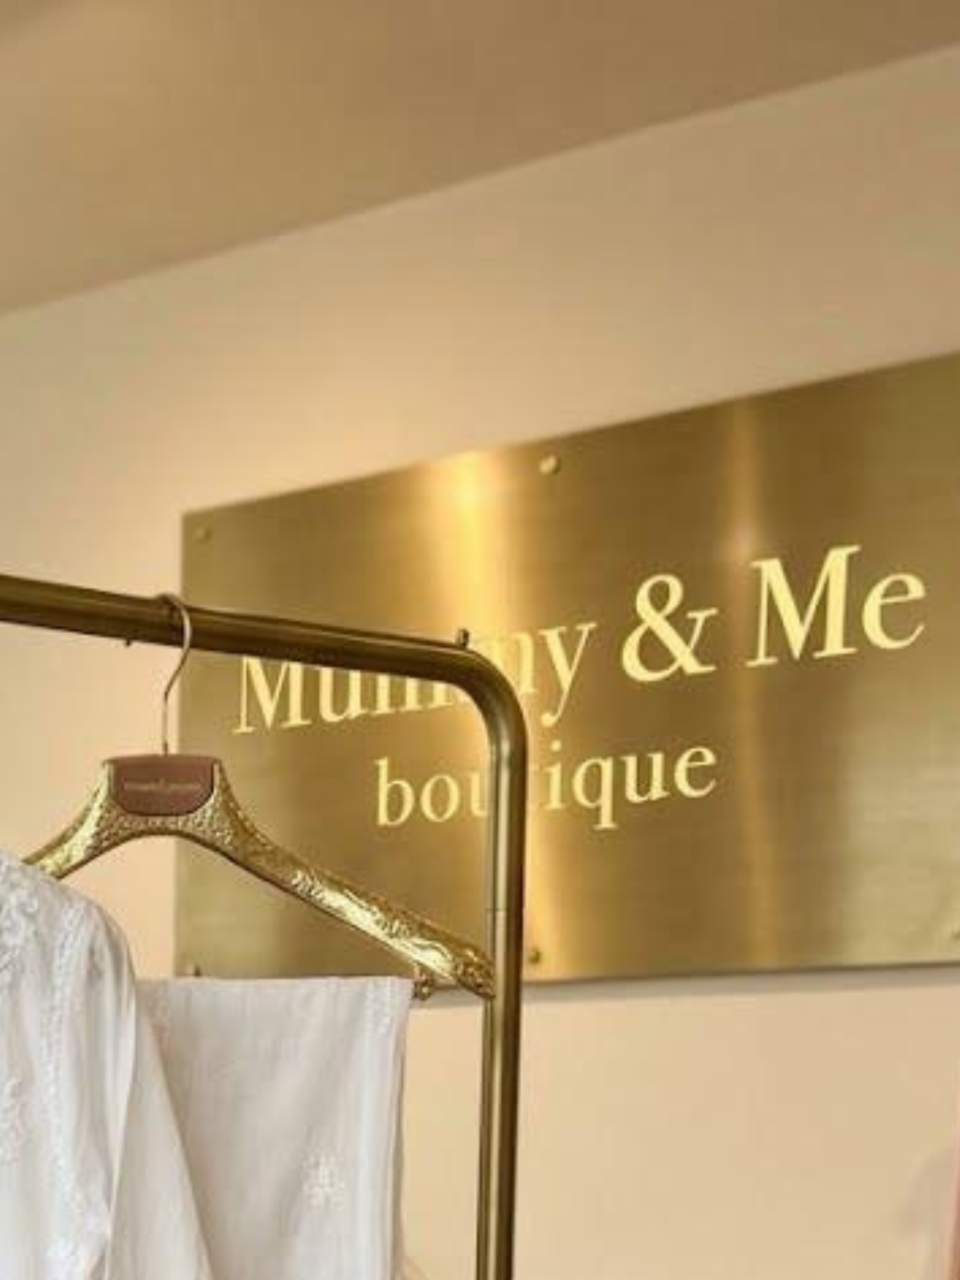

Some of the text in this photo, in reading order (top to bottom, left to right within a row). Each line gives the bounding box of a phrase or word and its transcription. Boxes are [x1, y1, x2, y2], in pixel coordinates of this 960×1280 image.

[620, 573, 720, 682] &
[744, 544, 927, 668] Me
[373, 740, 718, 831] boique
